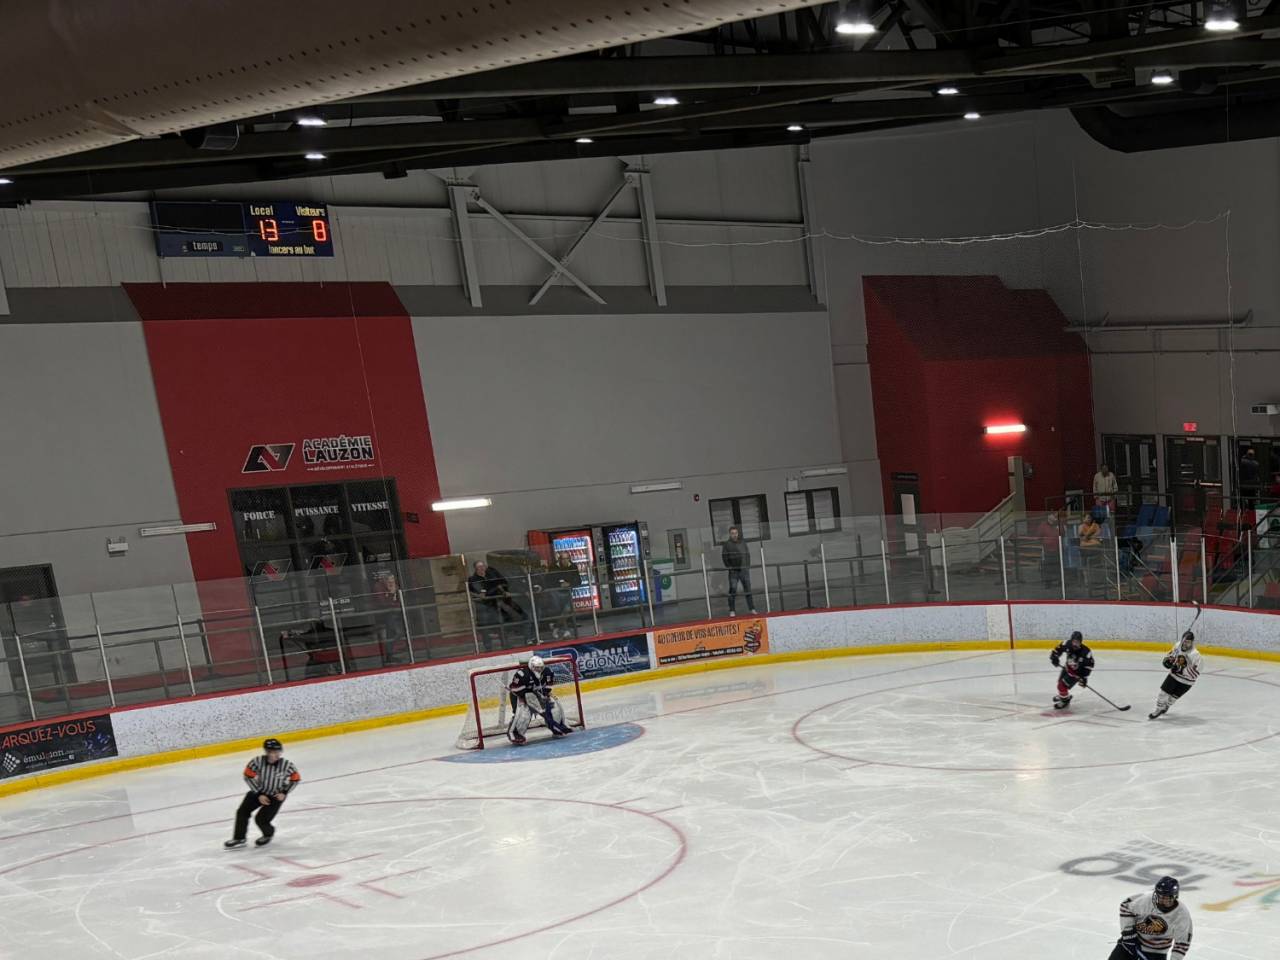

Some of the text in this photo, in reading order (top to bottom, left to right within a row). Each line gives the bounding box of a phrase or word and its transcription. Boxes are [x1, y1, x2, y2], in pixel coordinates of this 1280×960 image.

[250, 205, 274, 216] Local
[259, 219, 279, 241] 13
[302, 434, 372, 450] ACADÉMIE
[303, 447, 375, 464] LAUZON
[294, 505, 340, 517] PUISSANCE
[351, 500, 390, 512] VITESSE
[243, 510, 276, 521] FORCE
[0, 720, 97, 749] ARQUEZ-VOUS
